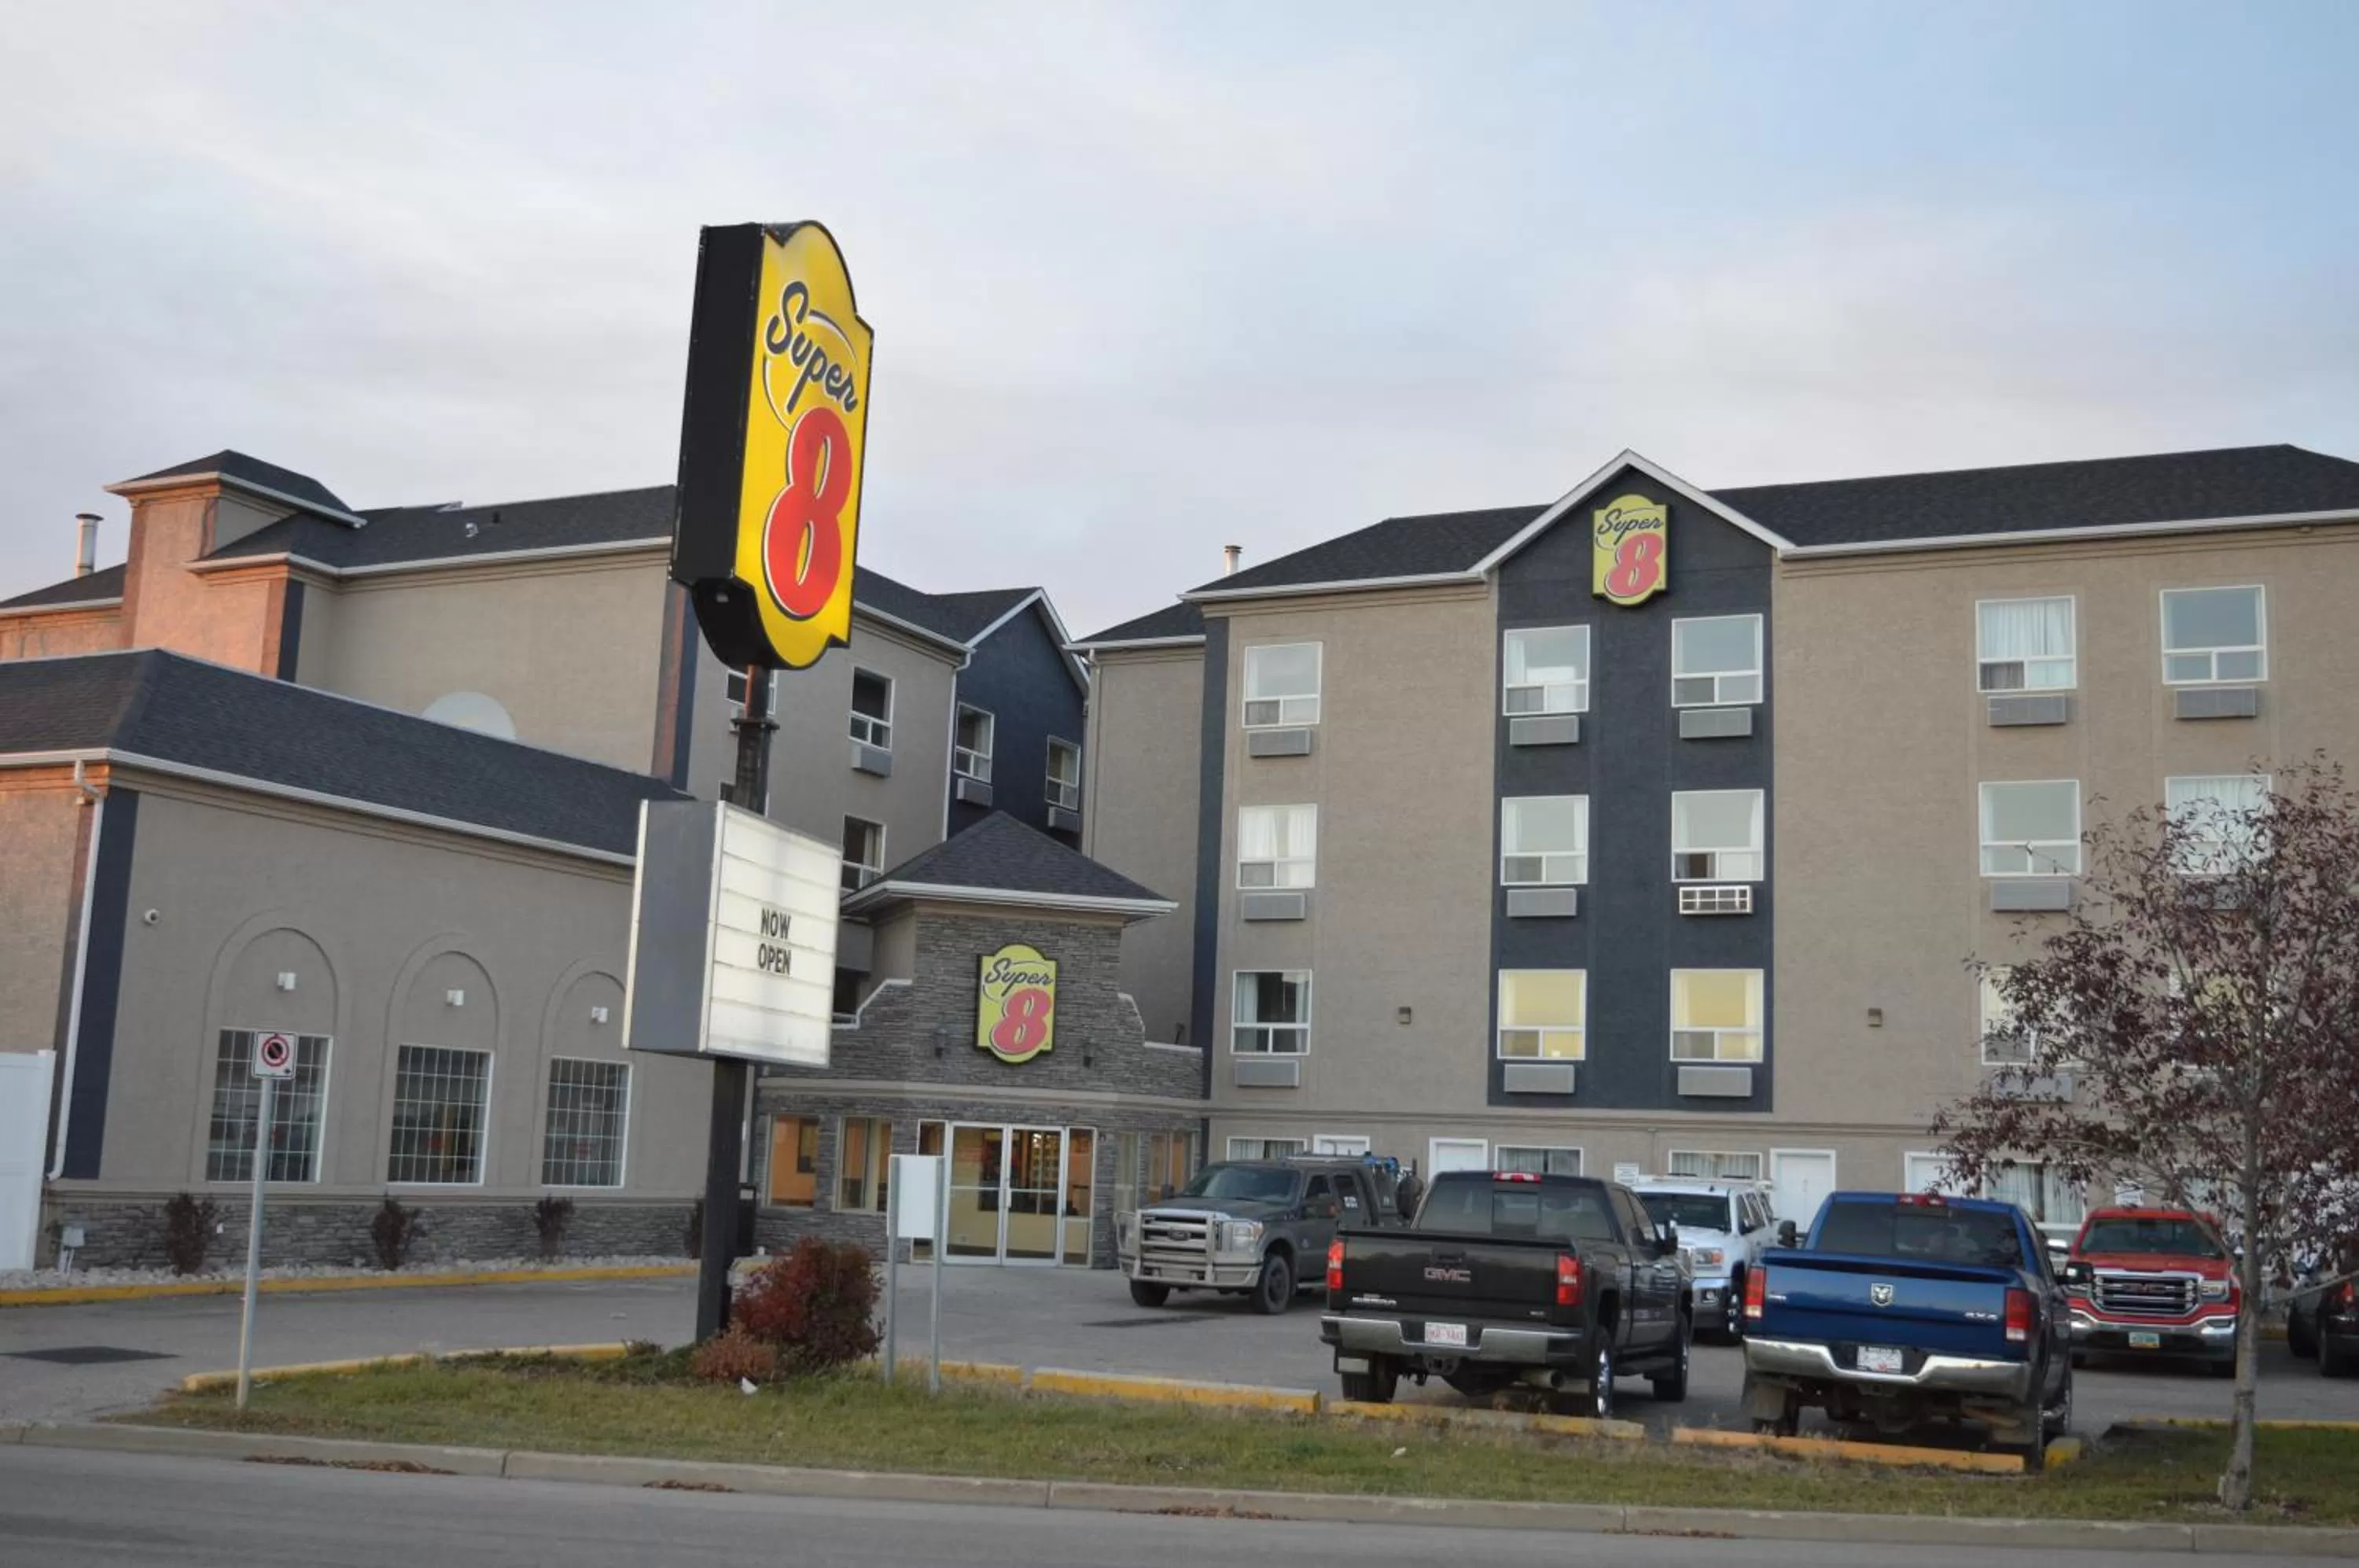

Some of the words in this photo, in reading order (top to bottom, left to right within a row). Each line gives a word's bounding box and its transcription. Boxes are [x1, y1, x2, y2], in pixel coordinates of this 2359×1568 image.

[764, 280, 858, 415] Super
[761, 406, 852, 622] 8
[1597, 508, 1664, 546] Super
[1603, 532, 1663, 598] 8
[760, 907, 792, 940] NOW
[758, 943, 792, 976] OPEN
[984, 958, 1054, 997] Super
[989, 988, 1051, 1055] 8
[1424, 1267, 1471, 1282] GMC
